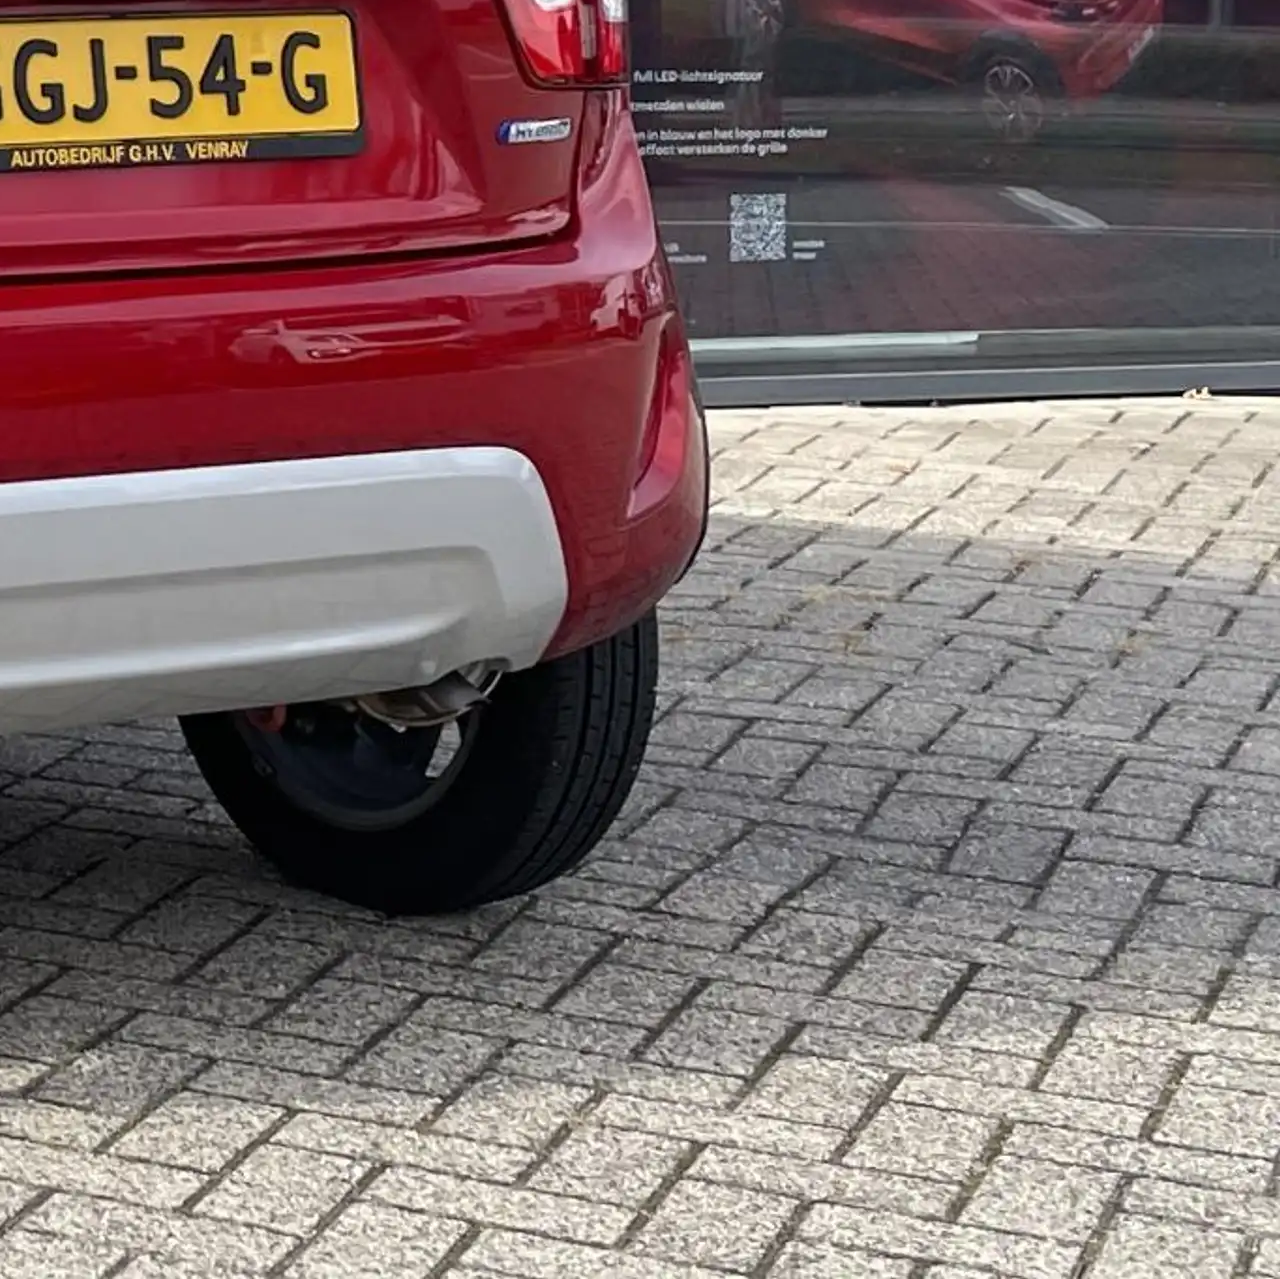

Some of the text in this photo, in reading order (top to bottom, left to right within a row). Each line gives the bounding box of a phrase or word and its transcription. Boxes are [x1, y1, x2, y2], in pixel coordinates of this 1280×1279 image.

[10, 140, 250, 168] AUTOBEDRIJF G.H.V. VENRAY
